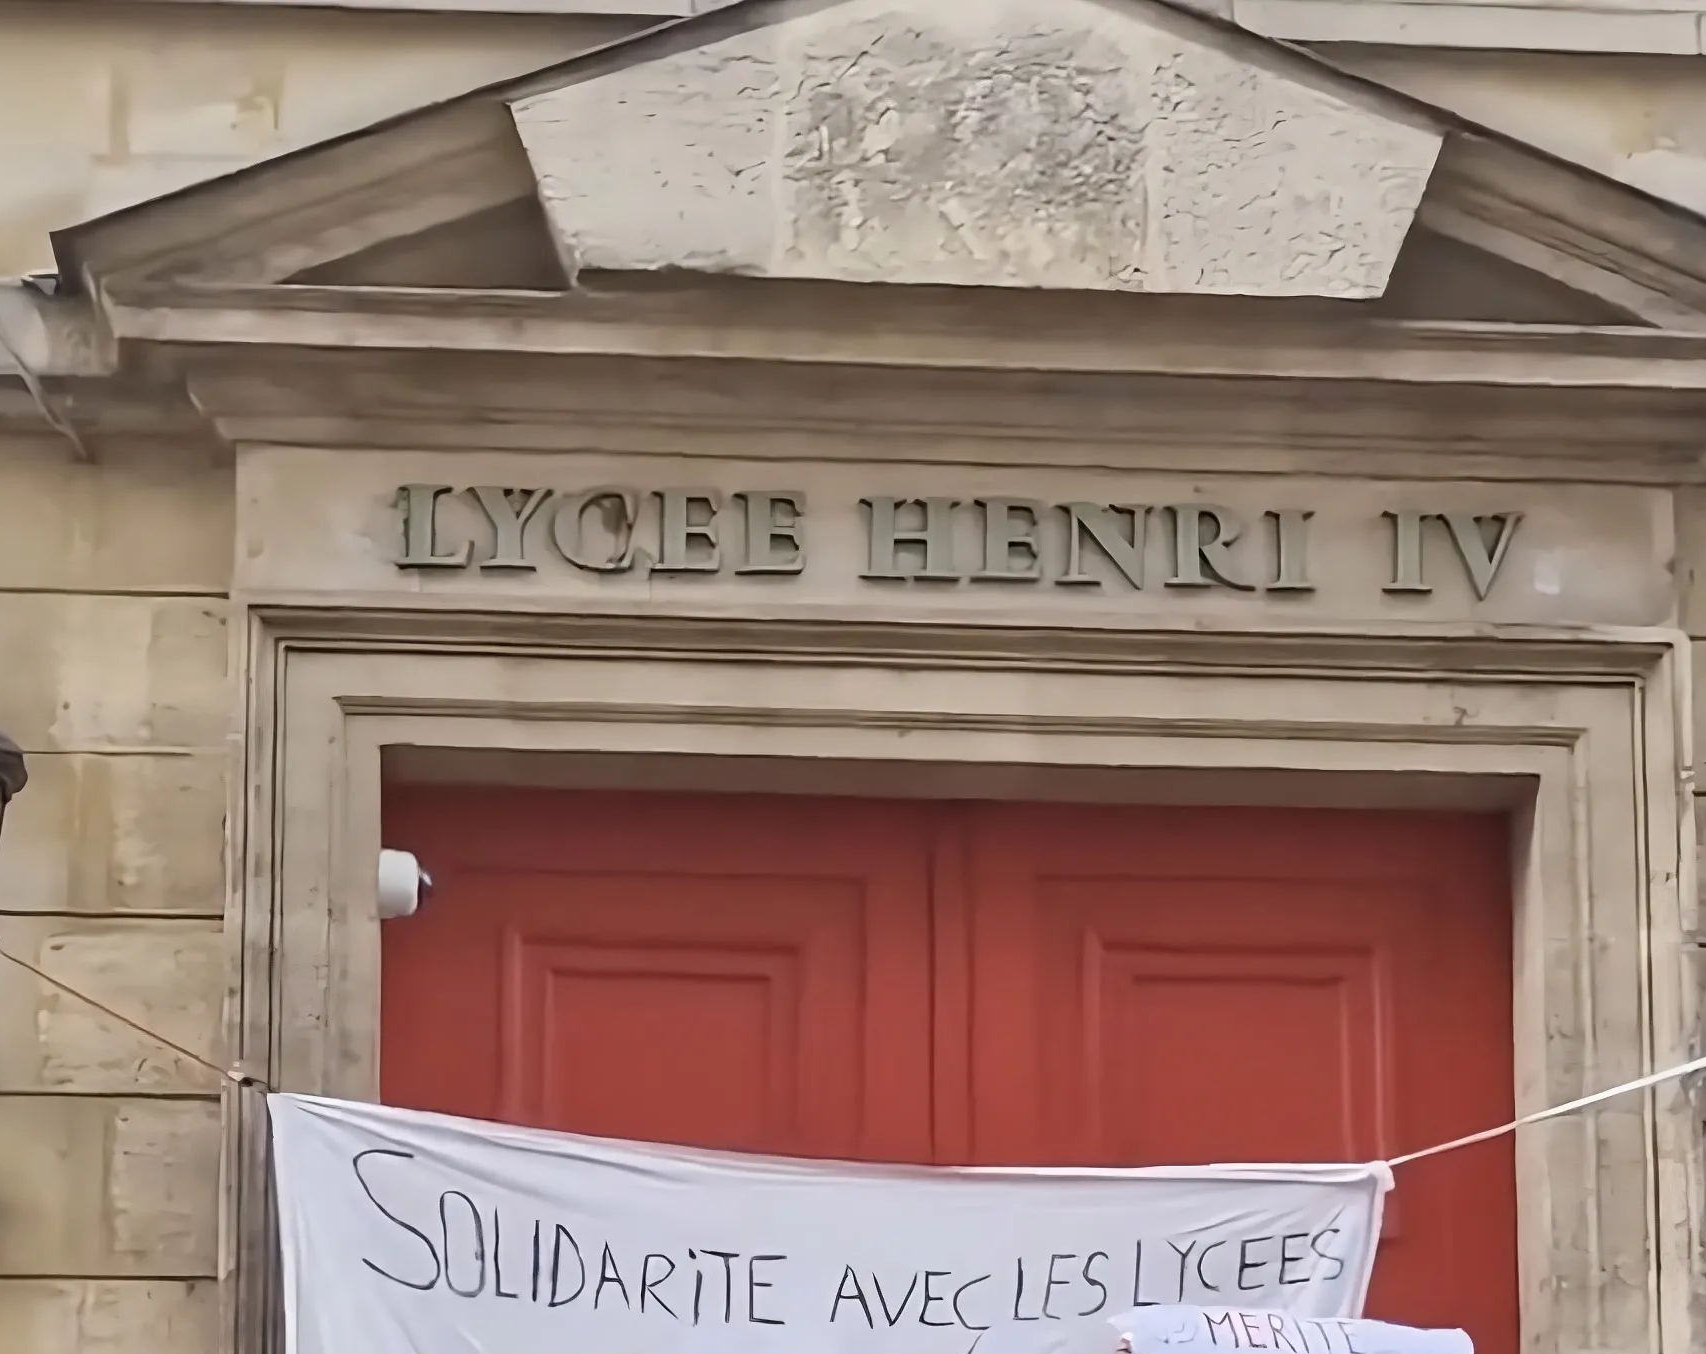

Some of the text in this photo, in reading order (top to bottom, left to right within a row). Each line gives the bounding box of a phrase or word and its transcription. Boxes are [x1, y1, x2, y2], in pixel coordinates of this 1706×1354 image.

[395, 482, 1526, 601] LYCEE HENRI IV
[829, 1263, 993, 1332] AVEC
[1011, 1250, 1110, 1322] LES
[1131, 1228, 1347, 1308] LYCEES
